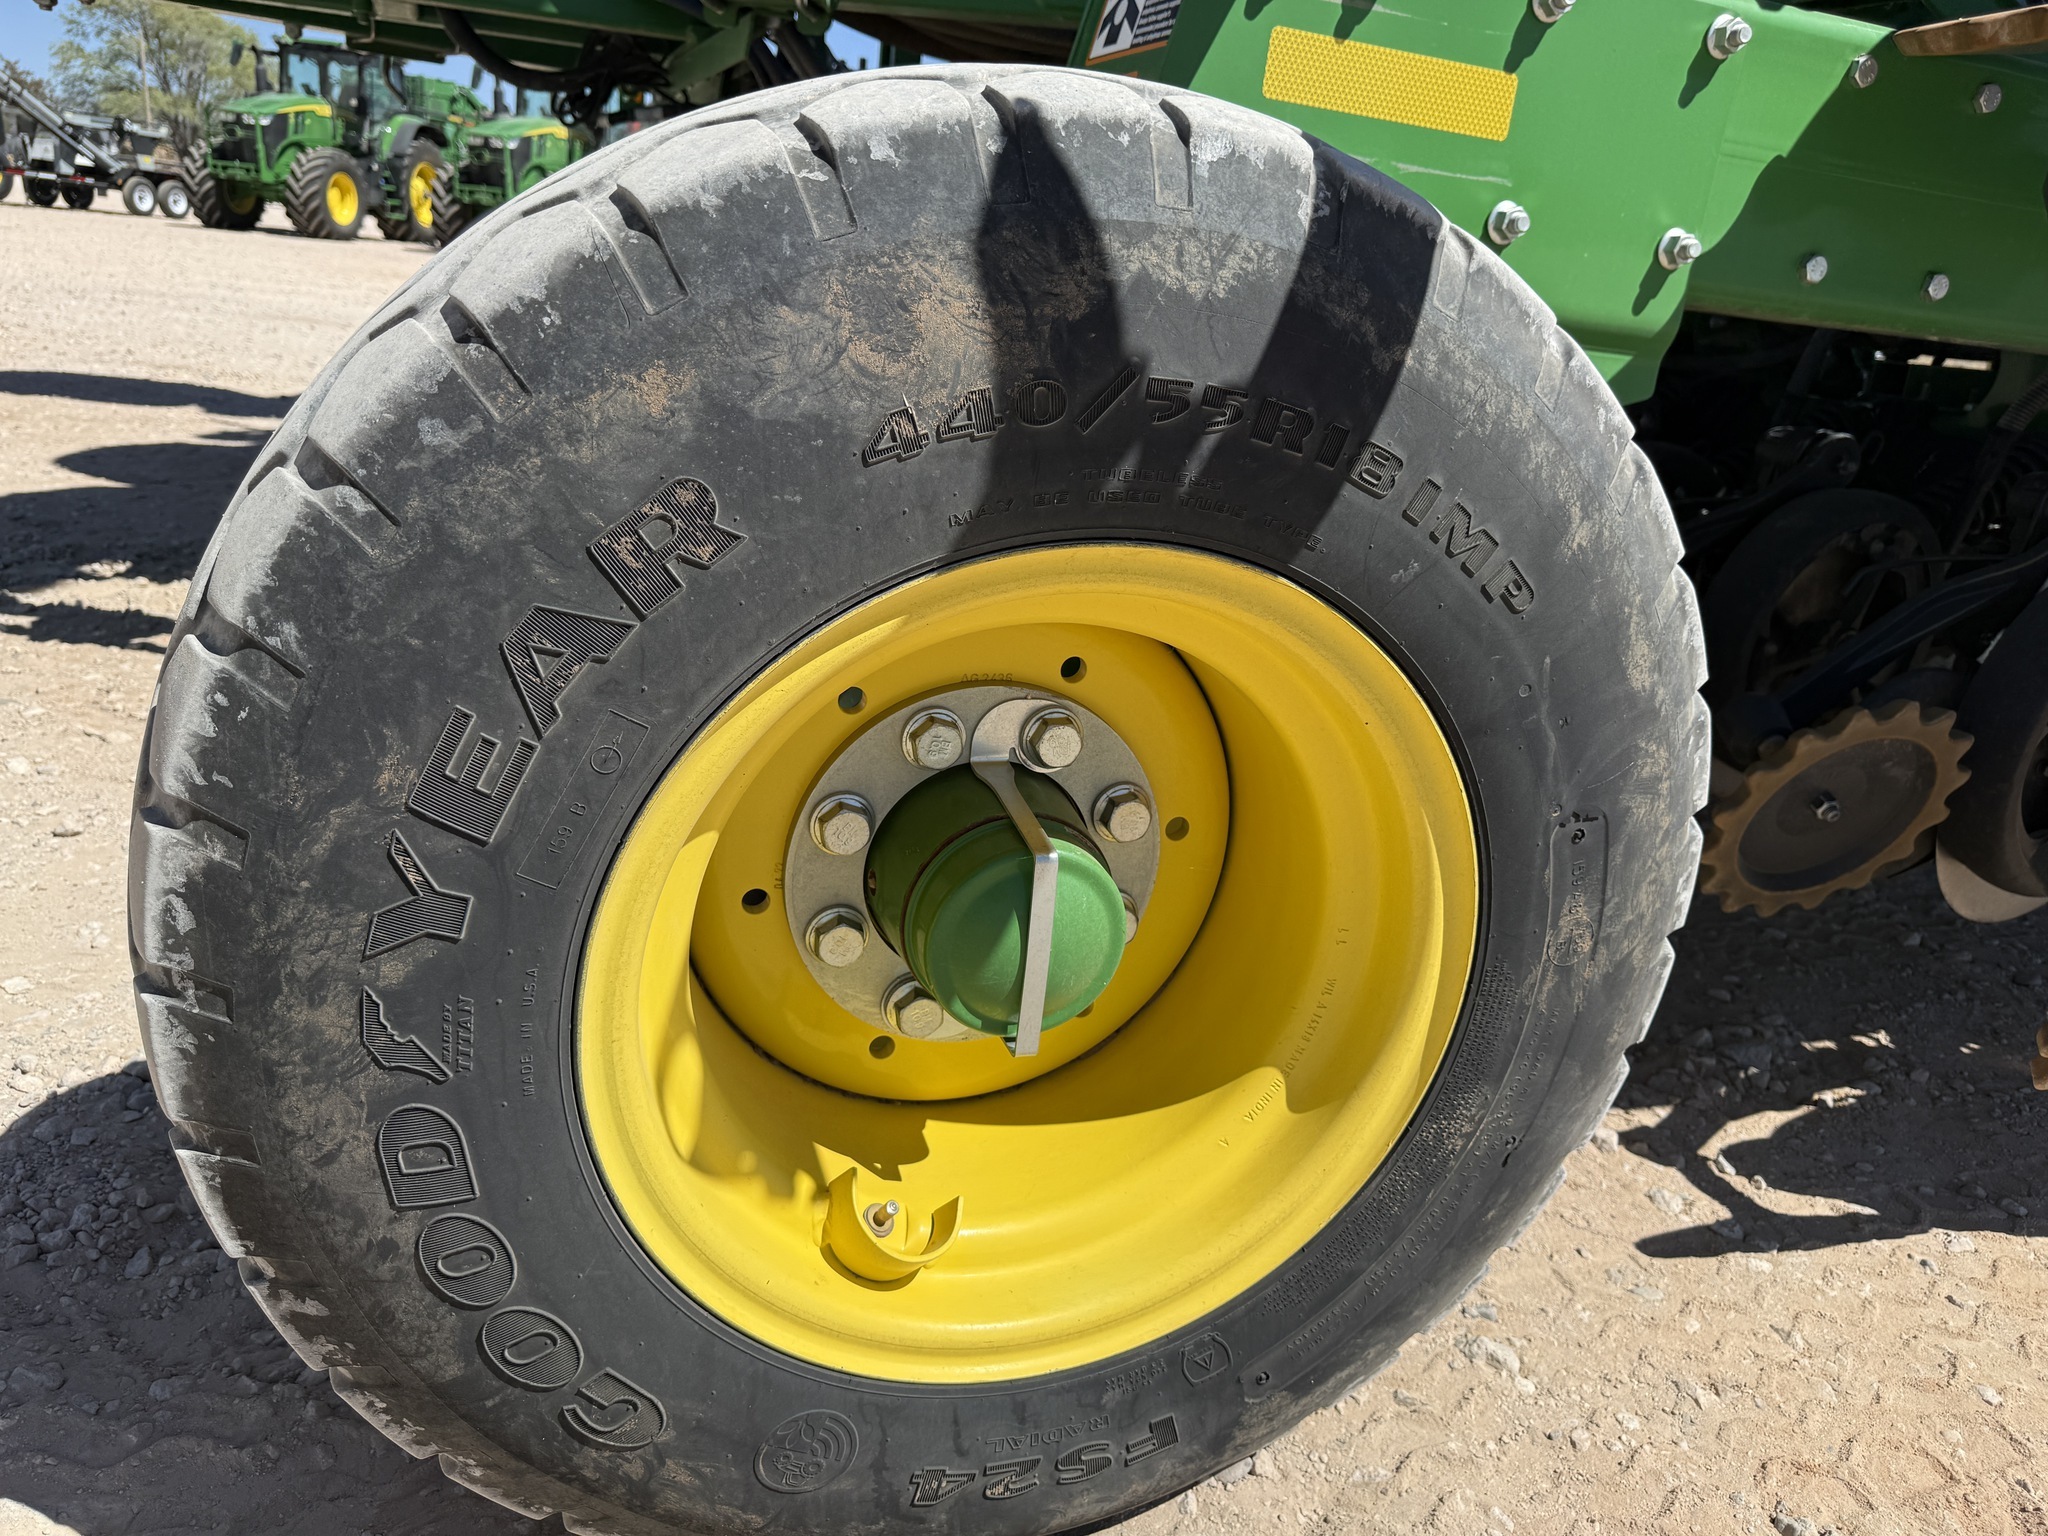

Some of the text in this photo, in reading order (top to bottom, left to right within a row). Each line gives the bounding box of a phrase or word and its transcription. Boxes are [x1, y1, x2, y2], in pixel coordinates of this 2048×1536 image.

[1081, 466, 1223, 491] TUBELESS
[948, 499, 1016, 528] MAY
[1032, 489, 1071, 509] BE
[1087, 487, 1162, 505] USED
[1178, 493, 1249, 521] TUBE
[1402, 477, 1536, 614] IMP
[455, 994, 474, 1073] TITAN
[520, 1022, 533, 1039] IN
[521, 1054, 535, 1098] MADE
[1243, 1093, 1274, 1124] INDIA
[984, 1414, 1113, 1454] RADIAL
[908, 1412, 1182, 1509] FS24
